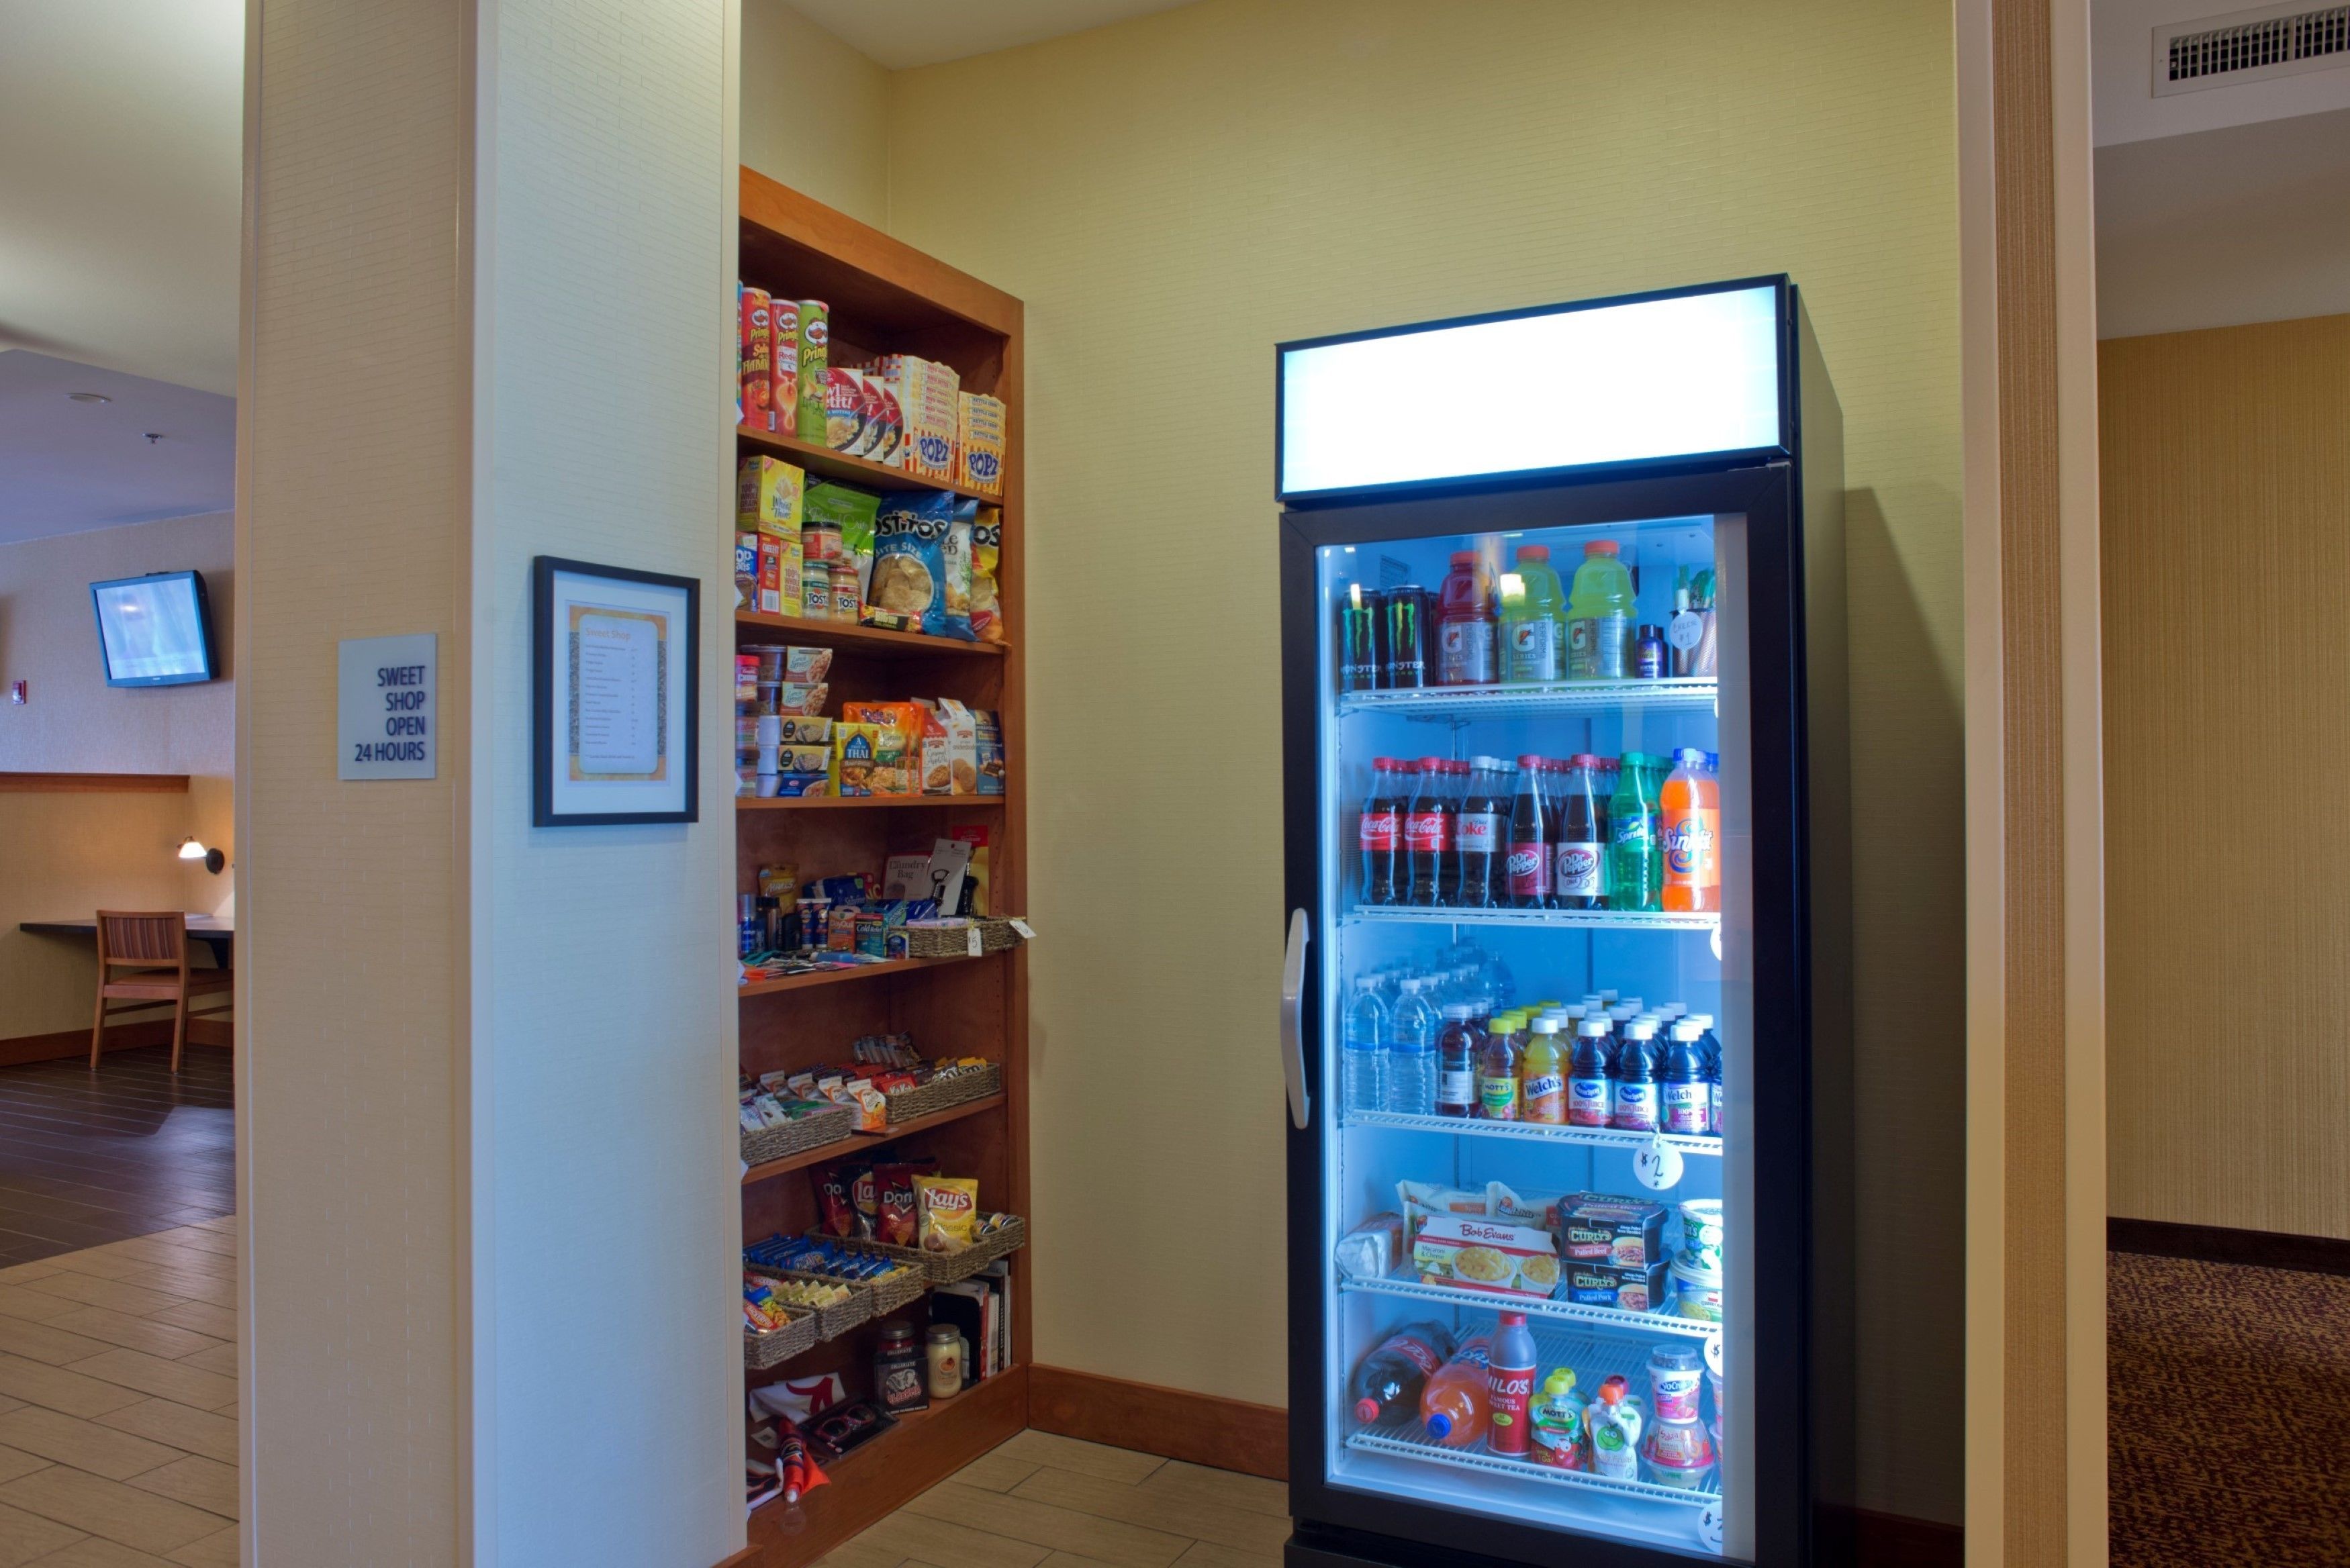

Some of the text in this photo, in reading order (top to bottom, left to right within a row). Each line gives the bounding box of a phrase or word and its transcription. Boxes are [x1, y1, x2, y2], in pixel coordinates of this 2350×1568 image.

[585, 627, 630, 642] Sweet Shop
[377, 665, 425, 687] SWEET
[385, 691, 425, 711] SHOP
[385, 716, 425, 736] OPEN
[355, 741, 425, 761] 24 HOURS
[847, 748, 869, 758] THAI
[1361, 816, 1401, 834] Coca-Cola
[1405, 816, 1444, 834] Coca-Cola
[890, 860, 926, 870] Laundry
[1507, 854, 1538, 873] Pepper
[1516, 853, 1529, 863] Dr
[1564, 856, 1595, 875] Pepper
[1571, 853, 1585, 863] Dr
[898, 870, 914, 880] Bag
[1525, 1076, 1562, 1096] Welch's
[1640, 1152, 1664, 1177] $2
[928, 1189, 968, 1211] Lay's
[932, 1222, 967, 1232] Classic
[1459, 1224, 1515, 1241] Bob Evans
[1571, 1230, 1611, 1244] CURLY'S
[1421, 1244, 1445, 1254] Macaroni
[1575, 1248, 1593, 1256] Pulled
[1576, 1275, 1615, 1290] CURLY'S
[1491, 1395, 1515, 1404] FAMOUS
[1507, 1403, 1521, 1411] TEA
